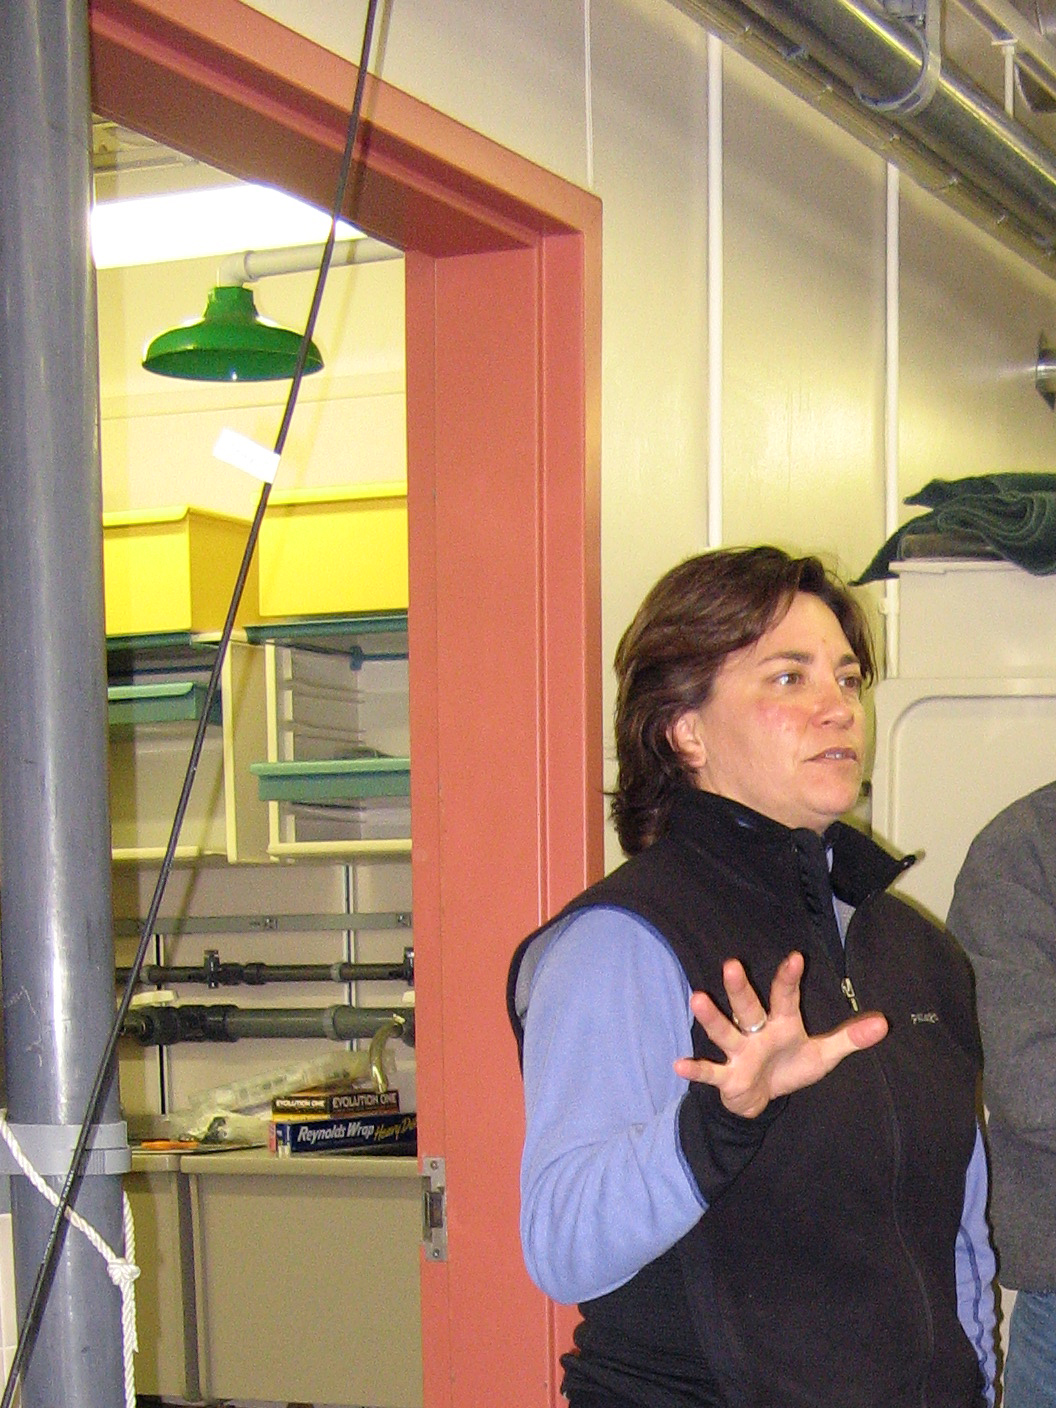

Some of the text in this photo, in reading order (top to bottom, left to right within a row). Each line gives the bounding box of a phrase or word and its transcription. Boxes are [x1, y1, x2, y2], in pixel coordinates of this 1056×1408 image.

[332, 1092, 398, 1108] EVOLUTION ONE
[297, 1124, 346, 1144] Reynolds
[346, 1121, 375, 1140] Wrap
